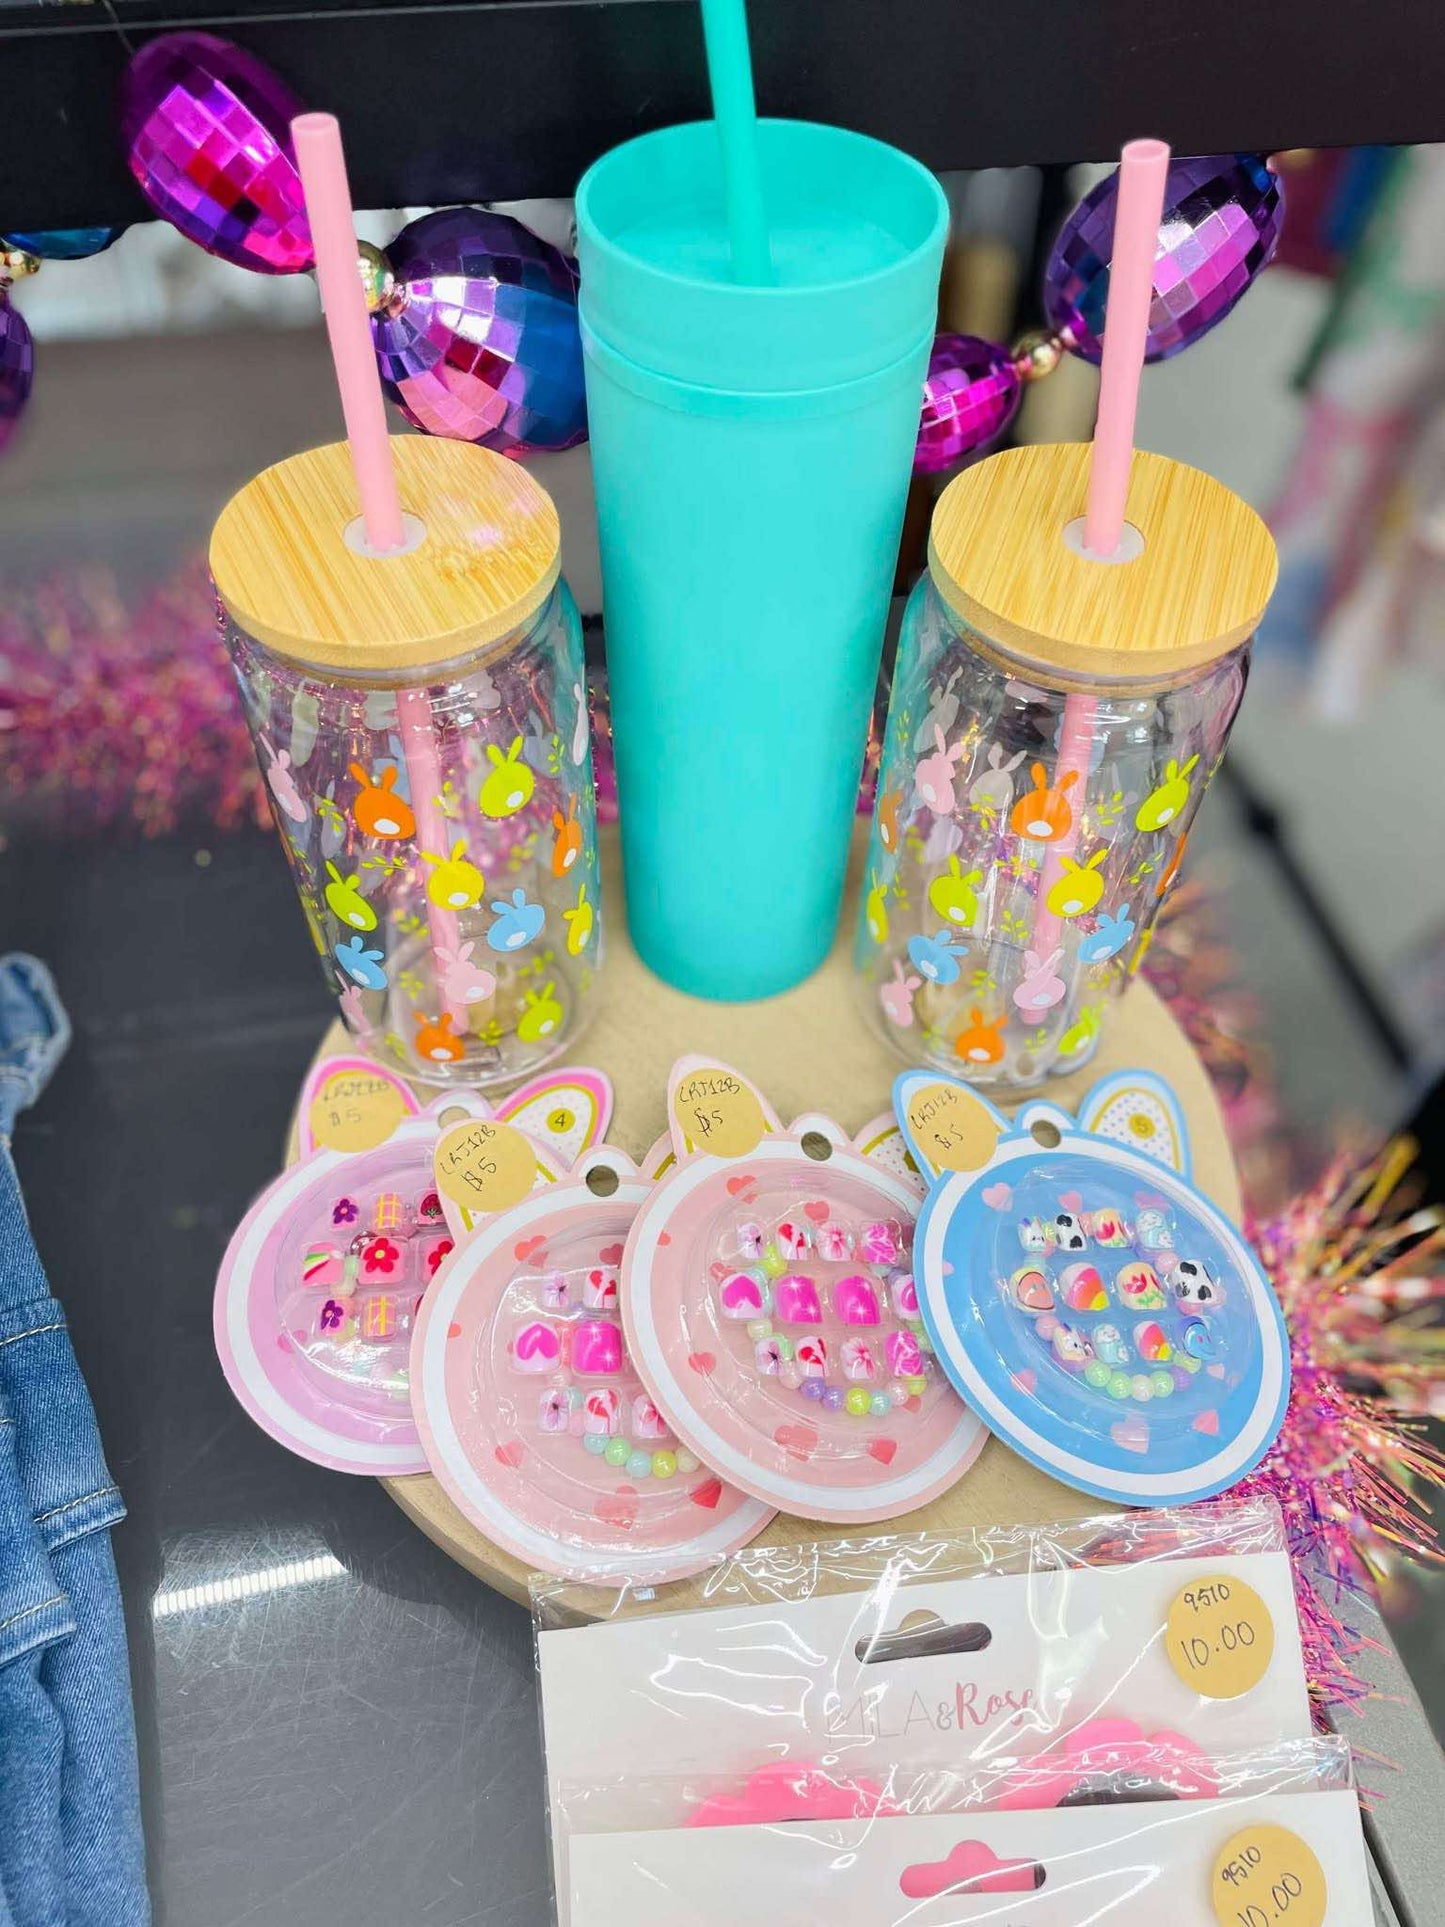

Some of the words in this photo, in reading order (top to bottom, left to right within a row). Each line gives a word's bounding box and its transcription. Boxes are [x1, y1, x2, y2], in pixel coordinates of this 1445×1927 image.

[554, 1112, 567, 1128] 4
[1183, 1583, 1230, 1612] 9510
[1180, 1621, 1255, 1670] 10.00
[1222, 1845, 1262, 1887] 9510
